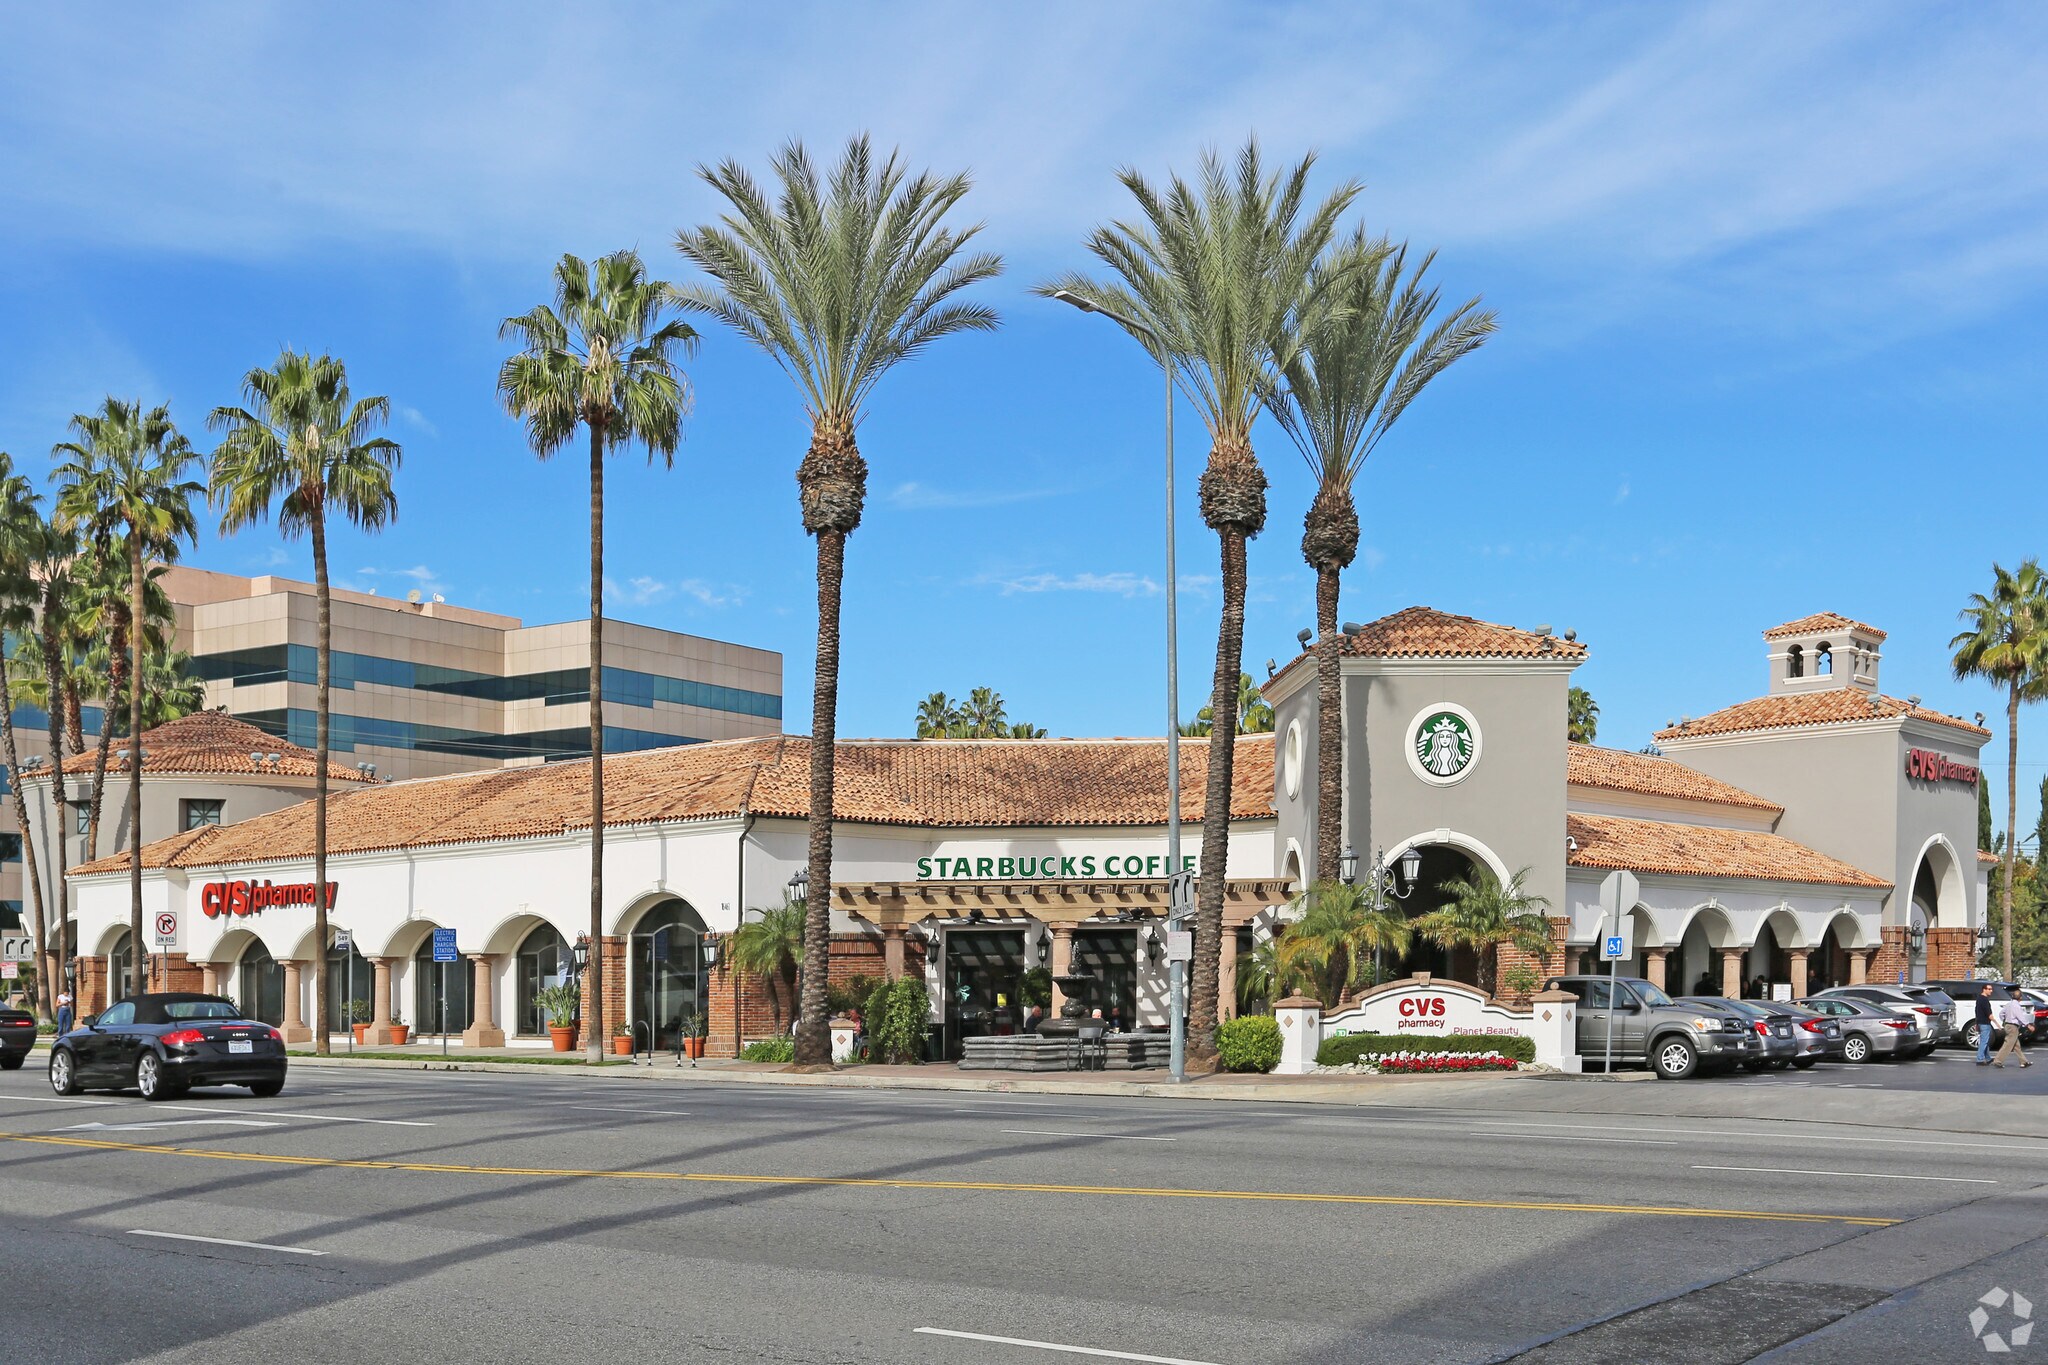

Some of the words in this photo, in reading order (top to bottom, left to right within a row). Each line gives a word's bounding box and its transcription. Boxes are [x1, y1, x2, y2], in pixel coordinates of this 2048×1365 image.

[917, 855, 1096, 877] STARBUCKS
[201, 879, 337, 917] CVS/pharmay
[1398, 997, 1446, 1017] CVS
[1398, 1018, 1446, 1030] pharmacy
[1453, 1026, 1484, 1036] Planet
[1486, 1026, 1519, 1036] Beauty
